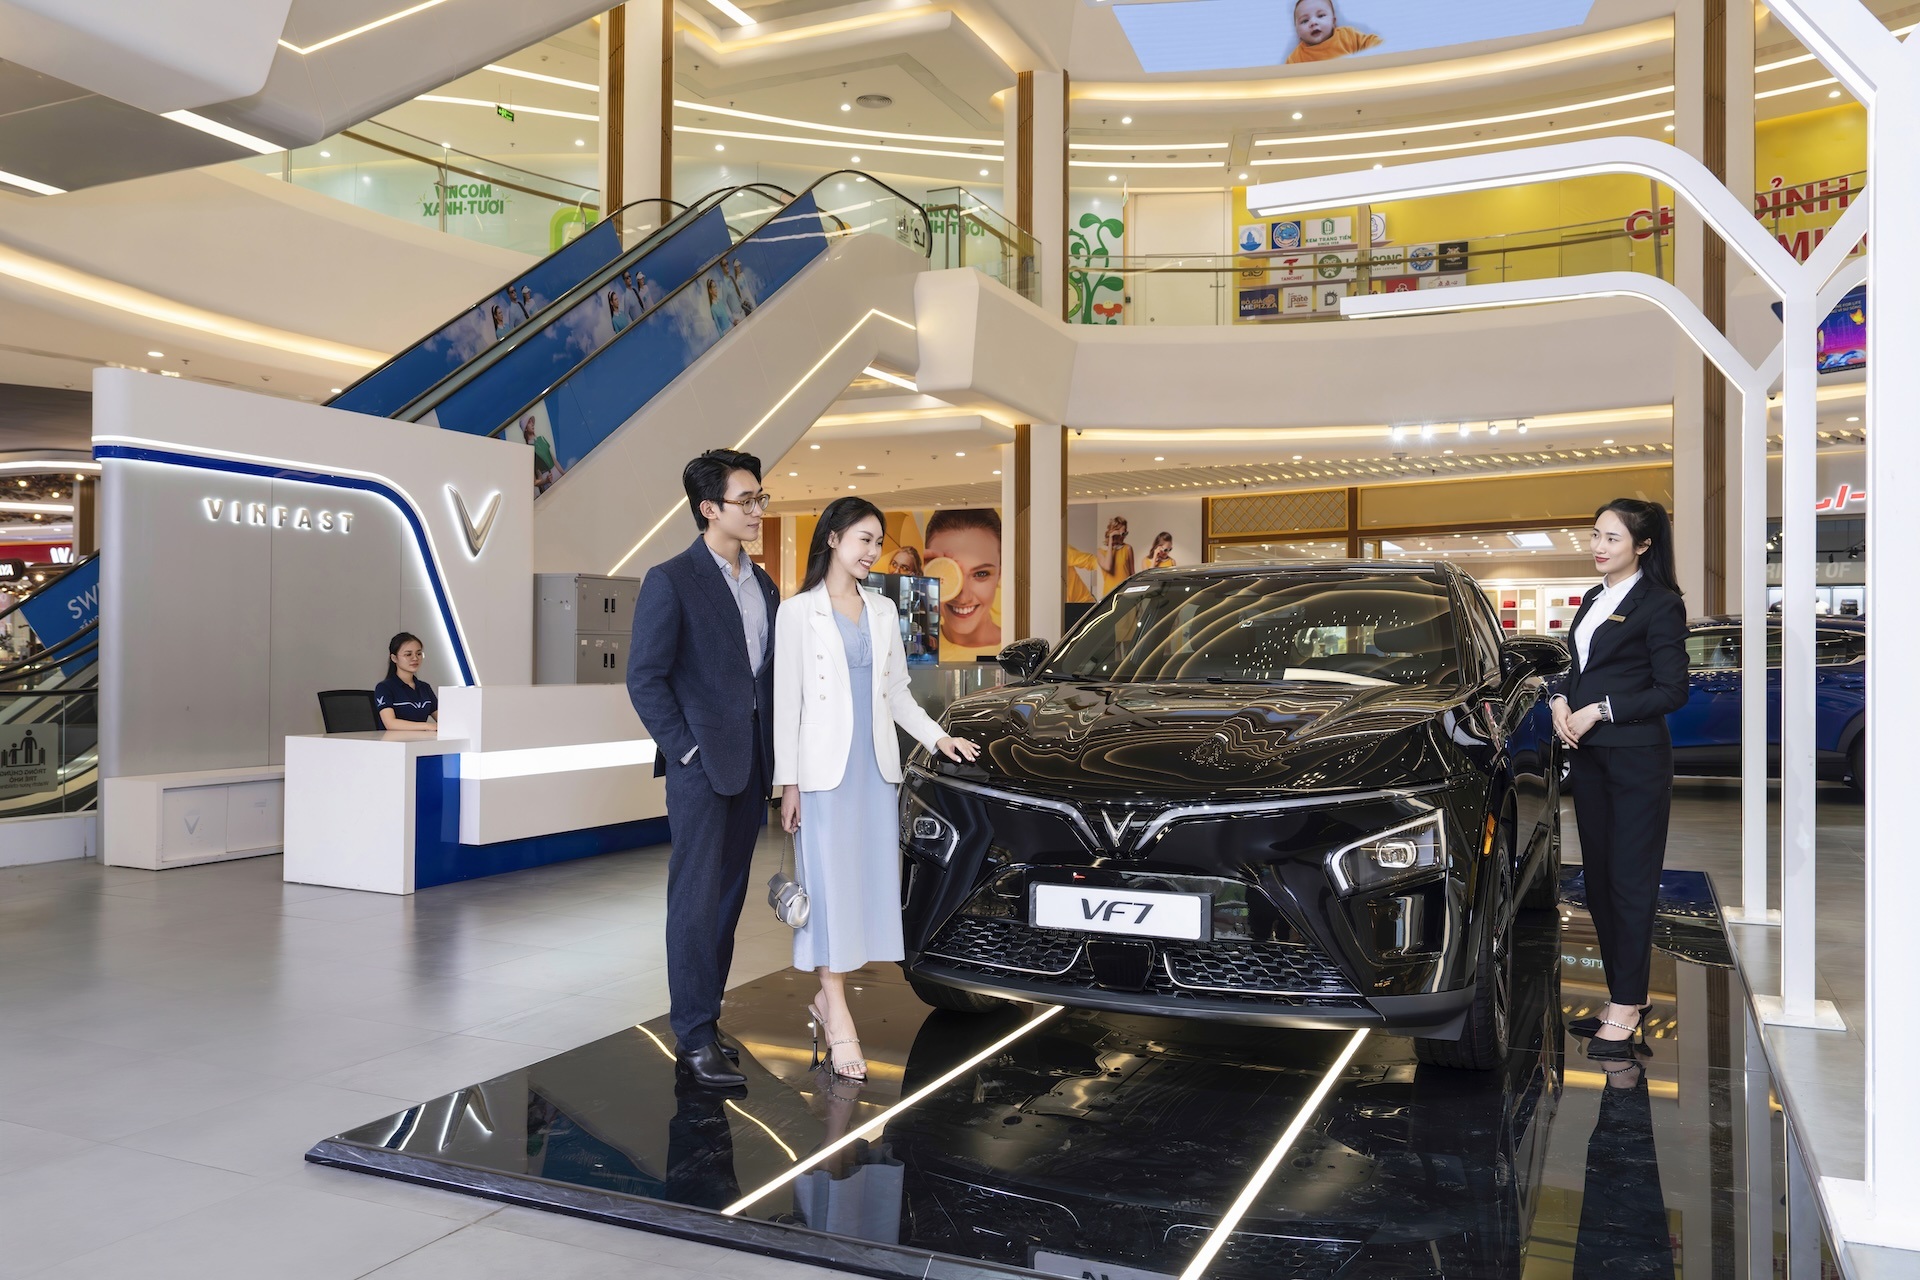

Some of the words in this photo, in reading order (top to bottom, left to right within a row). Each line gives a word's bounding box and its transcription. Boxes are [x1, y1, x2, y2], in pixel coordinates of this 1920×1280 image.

[204, 499, 353, 533] VINFAST
[67, 582, 99, 619] SW
[1081, 898, 1154, 924] VF7
